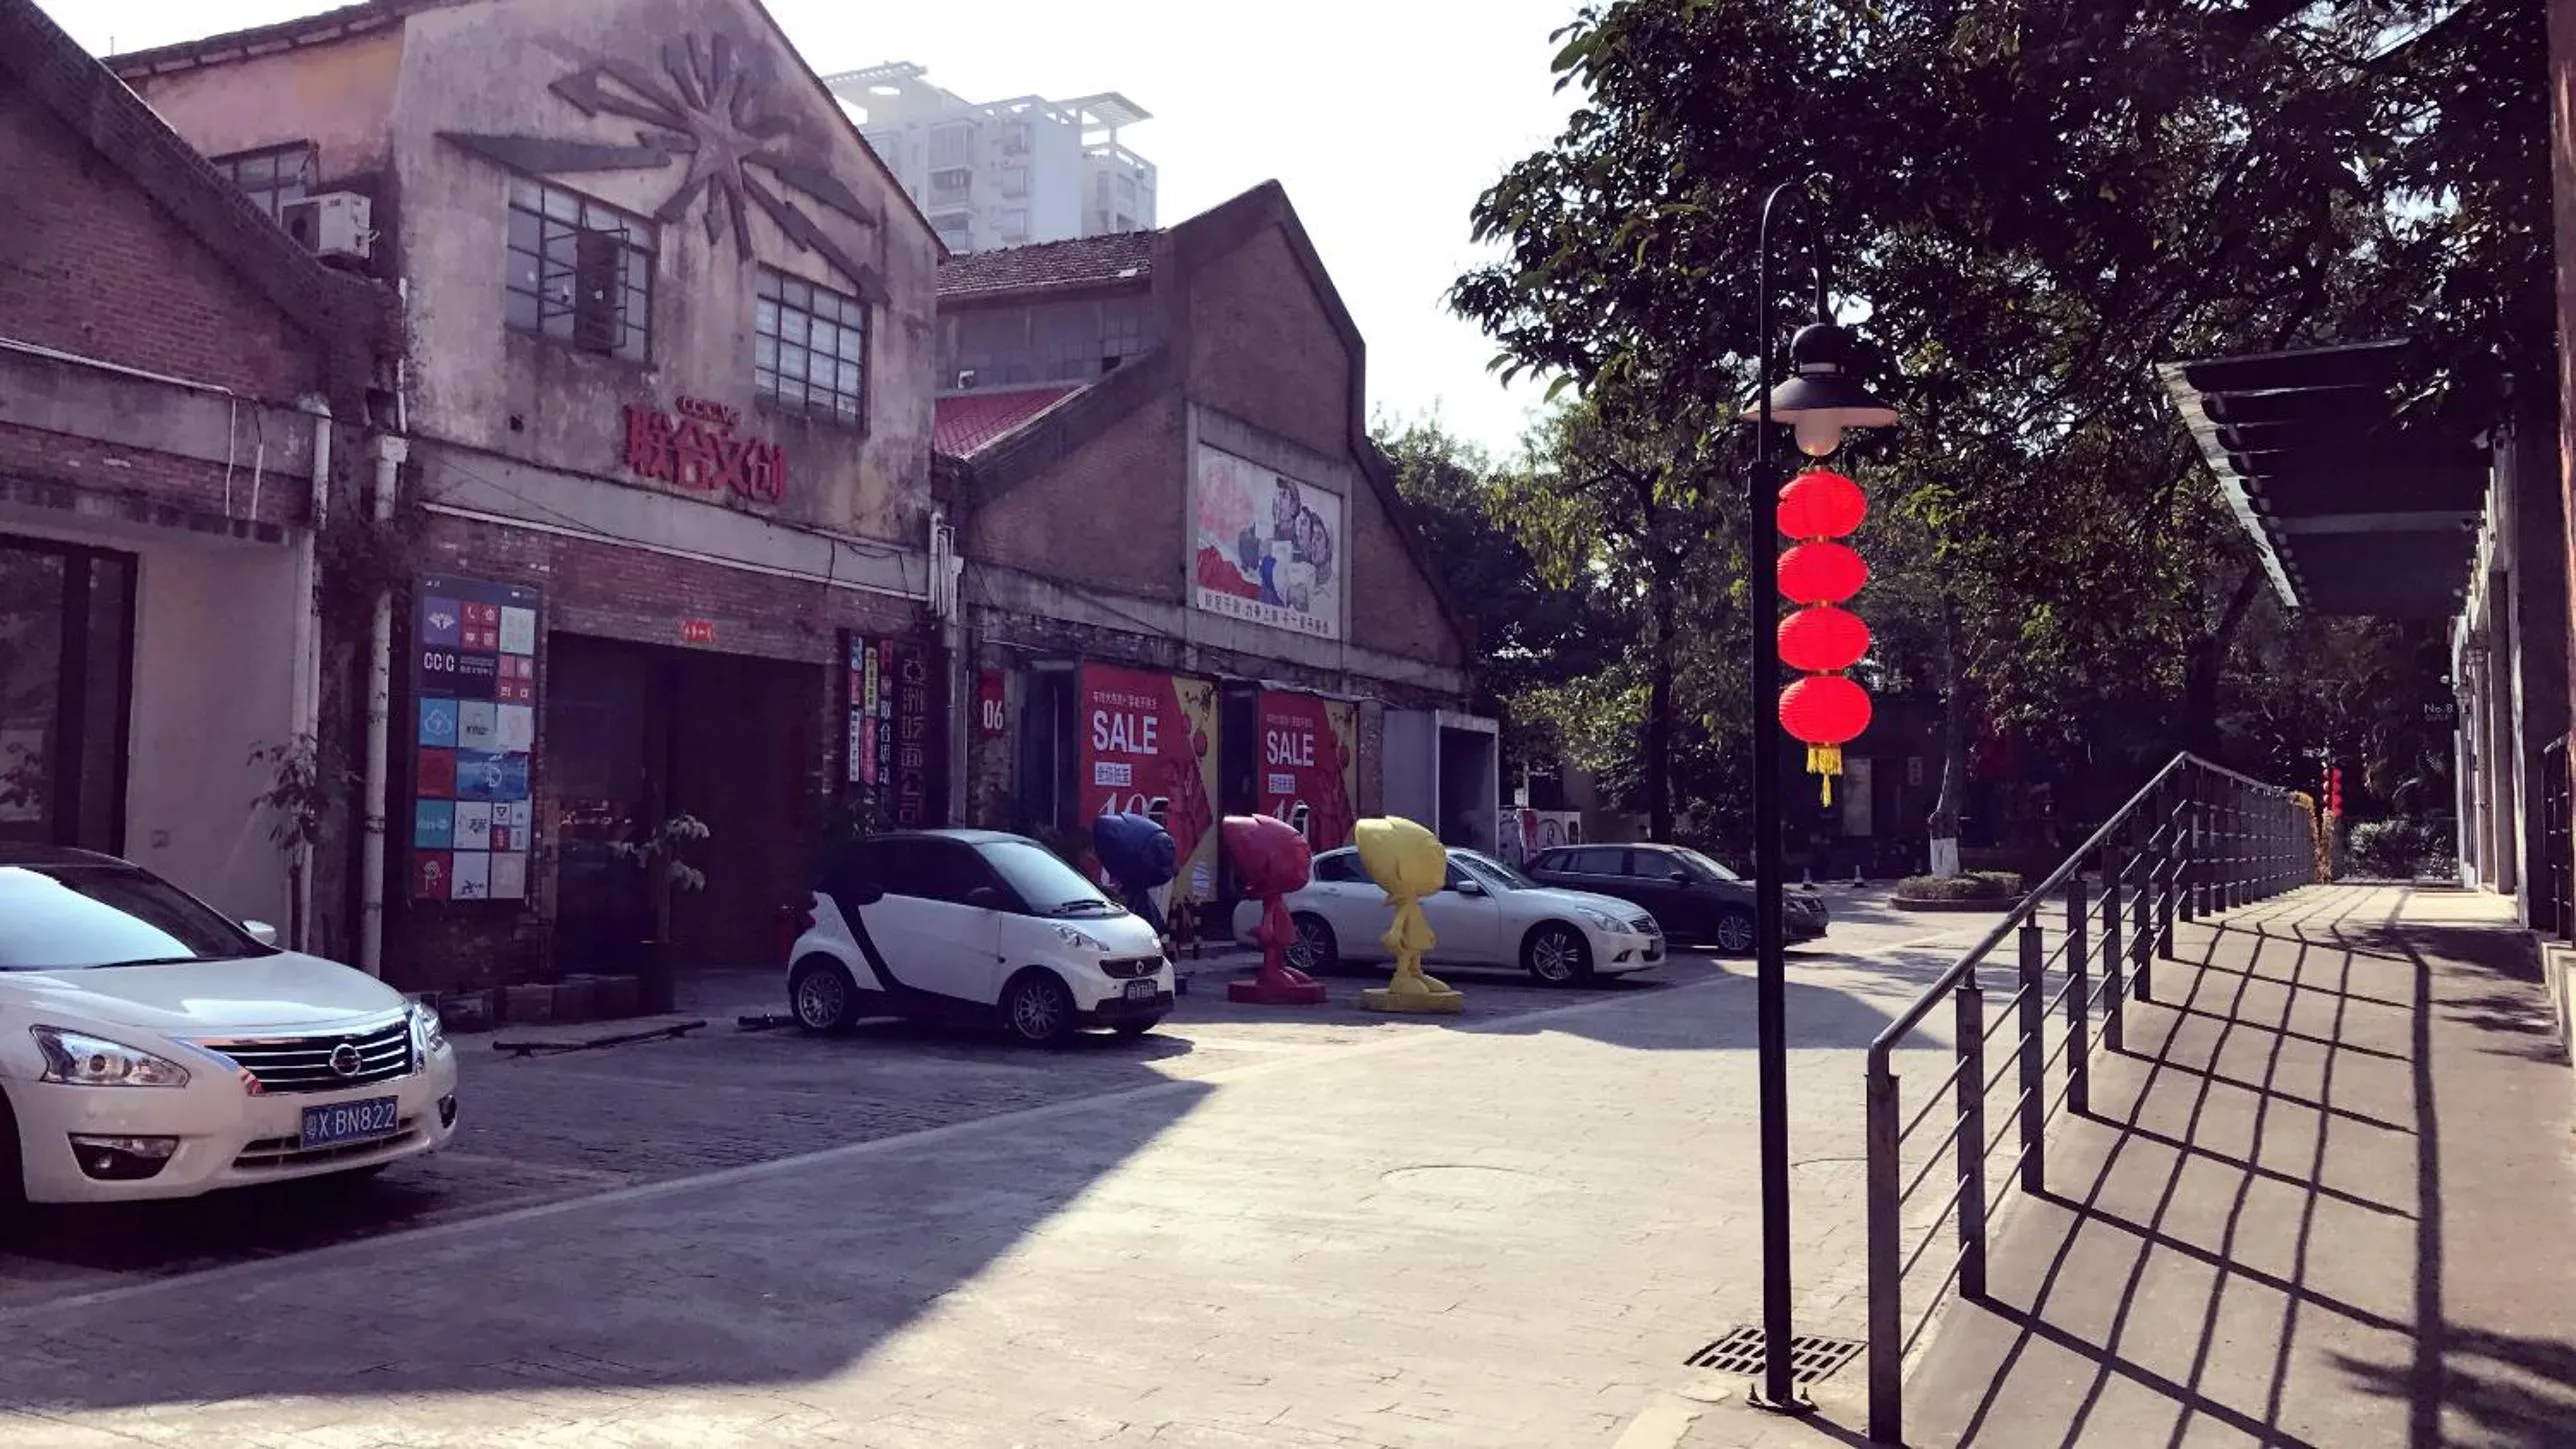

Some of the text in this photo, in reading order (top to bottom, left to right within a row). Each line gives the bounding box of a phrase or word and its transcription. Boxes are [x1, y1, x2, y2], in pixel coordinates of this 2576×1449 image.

[625, 403, 787, 505] 联合文创
[984, 699, 1003, 730] 06
[1092, 709, 1158, 755] SALE
[1266, 729, 1314, 767] SALE
